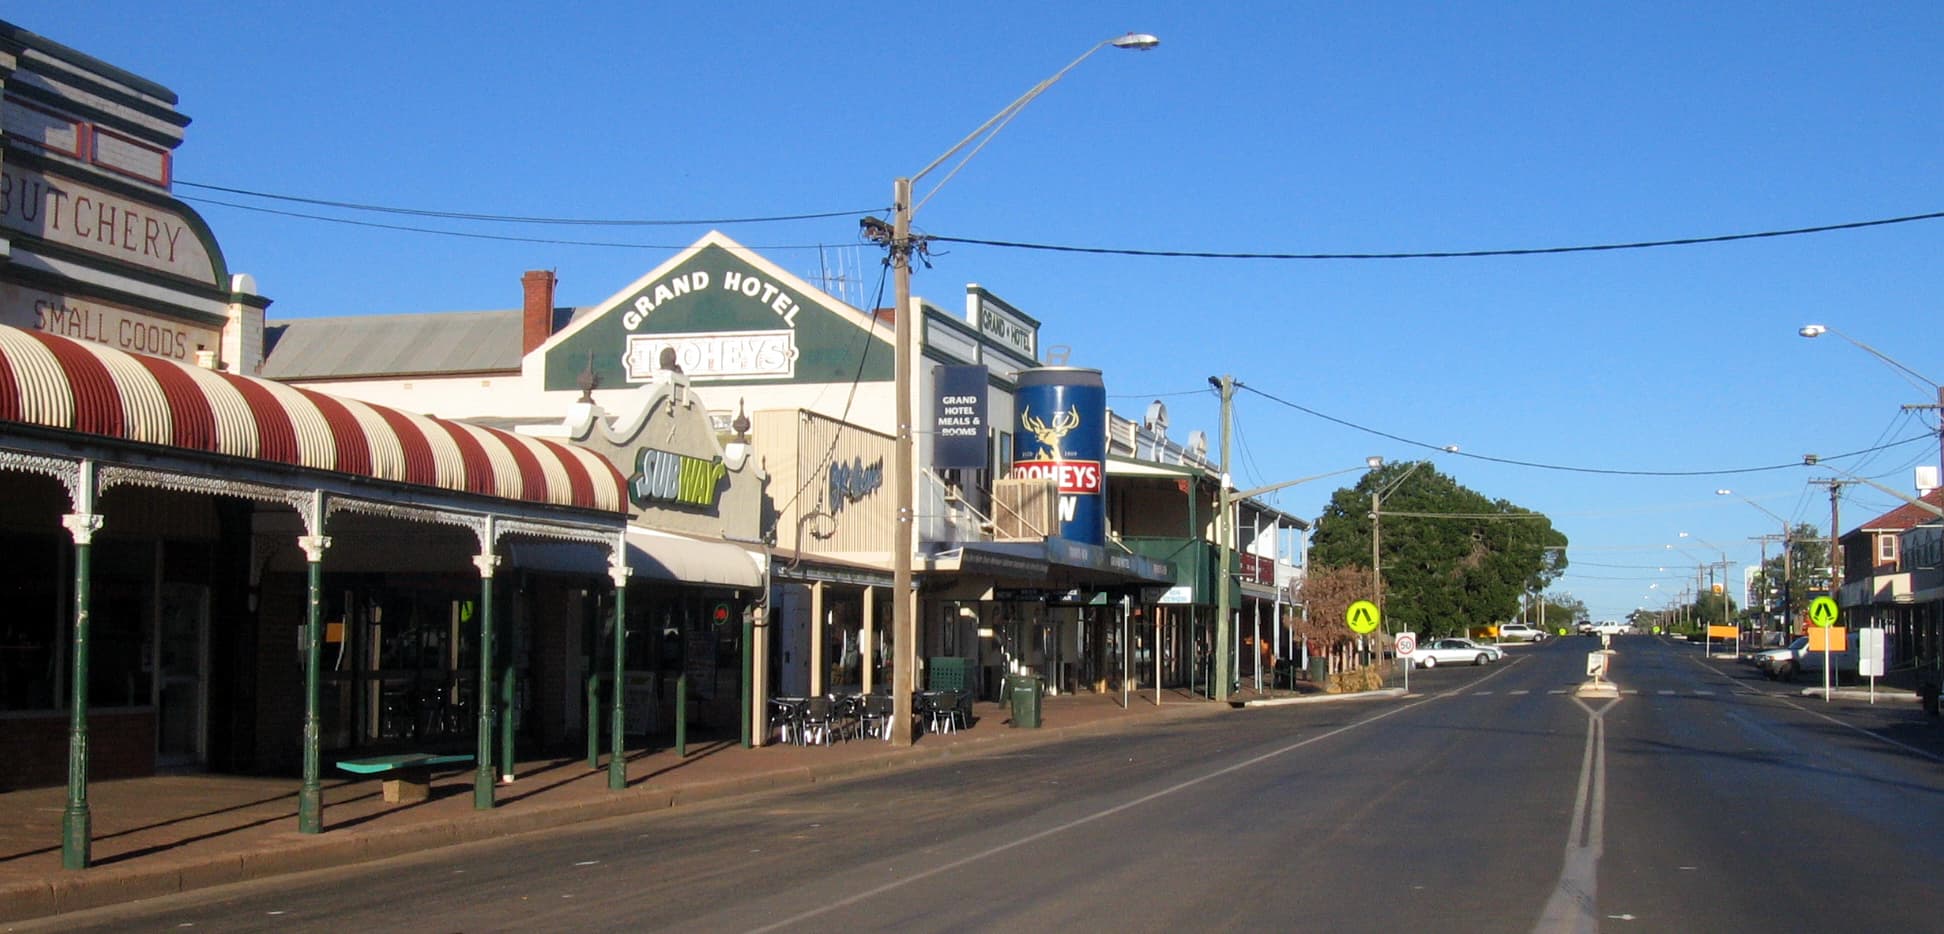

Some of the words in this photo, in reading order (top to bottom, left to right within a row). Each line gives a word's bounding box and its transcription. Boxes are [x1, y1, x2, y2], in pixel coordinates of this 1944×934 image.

[0, 171, 183, 263] BUTCHERY
[622, 271, 710, 331] GRAND
[723, 271, 800, 328] HOTEL
[33, 299, 109, 344] SMALL
[119, 318, 187, 361] GOODS
[982, 309, 1006, 338] GRAND
[1010, 324, 1032, 353] HOTEL
[942, 396, 977, 405] GRAND
[944, 406, 975, 415] HOTEL
[938, 417, 970, 426] MEALS
[972, 416, 981, 425] &
[942, 427, 977, 436] ROOMS
[635, 449, 726, 505] SUBWAY
[1400, 641, 1412, 650] 50
